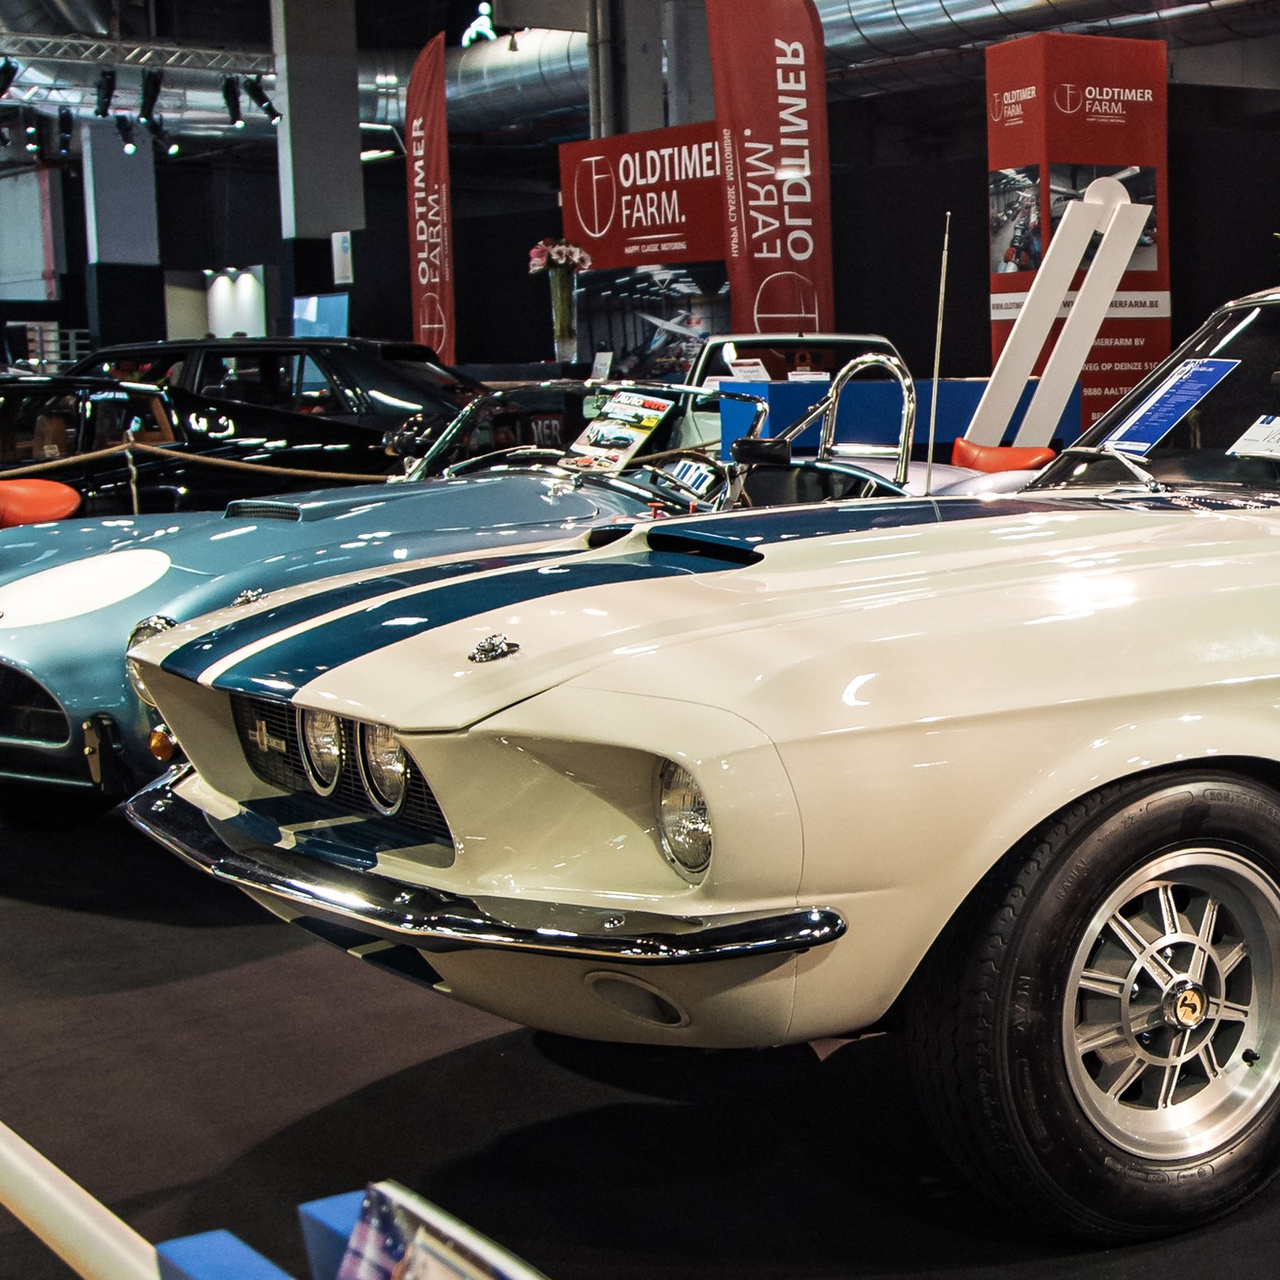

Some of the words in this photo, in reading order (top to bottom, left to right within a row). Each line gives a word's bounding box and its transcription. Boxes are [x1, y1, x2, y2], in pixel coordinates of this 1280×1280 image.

[1003, 86, 1036, 104] OLDTIMER
[1085, 86, 1153, 102] OLDTIMER
[1086, 101, 1126, 114] FARM.
[412, 116, 429, 285] OLDTIMER
[621, 190, 687, 228] FARM.
[1134, 337, 1145, 346] BV
[1101, 362, 1113, 371] OP
[1114, 362, 1142, 370] DEINZE
[1083, 388, 1102, 396] 9880
